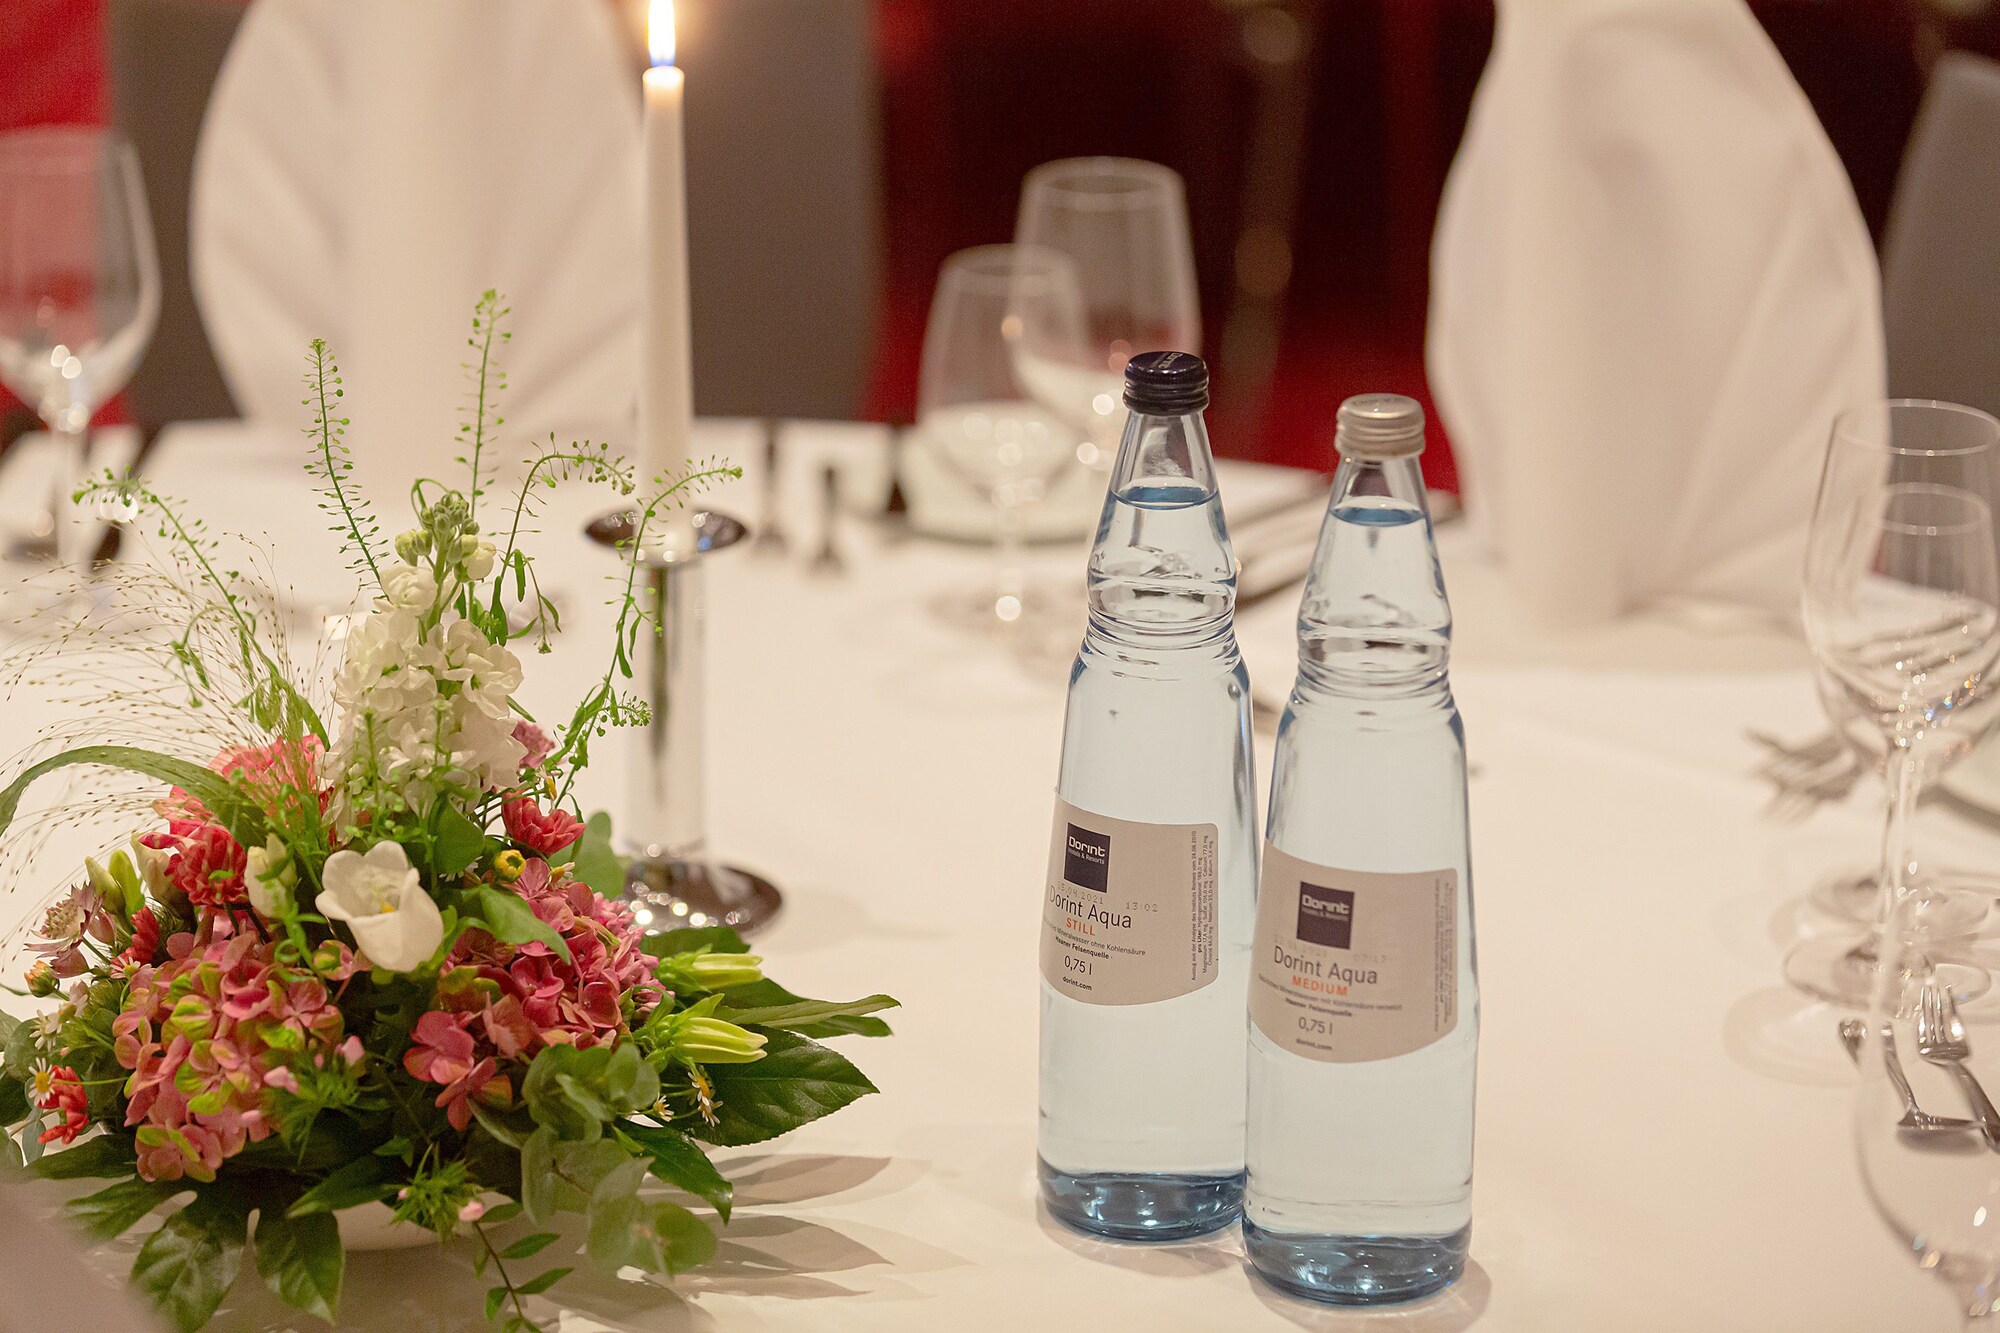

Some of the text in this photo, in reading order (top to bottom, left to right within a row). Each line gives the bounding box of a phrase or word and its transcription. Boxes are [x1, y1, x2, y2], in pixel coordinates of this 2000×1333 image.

[1068, 835, 1106, 857] Dorint
[1049, 885, 1083, 918] Dorint
[1087, 904, 1132, 929] Aqua
[1301, 894, 1350, 914] Dorint
[1066, 917, 1095, 936] STILL
[1091, 940, 1105, 950] ohne
[1106, 941, 1146, 956] Kohlensäure
[1064, 955, 1086, 973] 0,75
[1273, 945, 1322, 977] Dorint
[1328, 963, 1378, 986] Aqua
[1062, 976, 1093, 991] dorint.com
[1291, 975, 1348, 996] MEDIUM
[1298, 1016, 1326, 1034] 0,75
